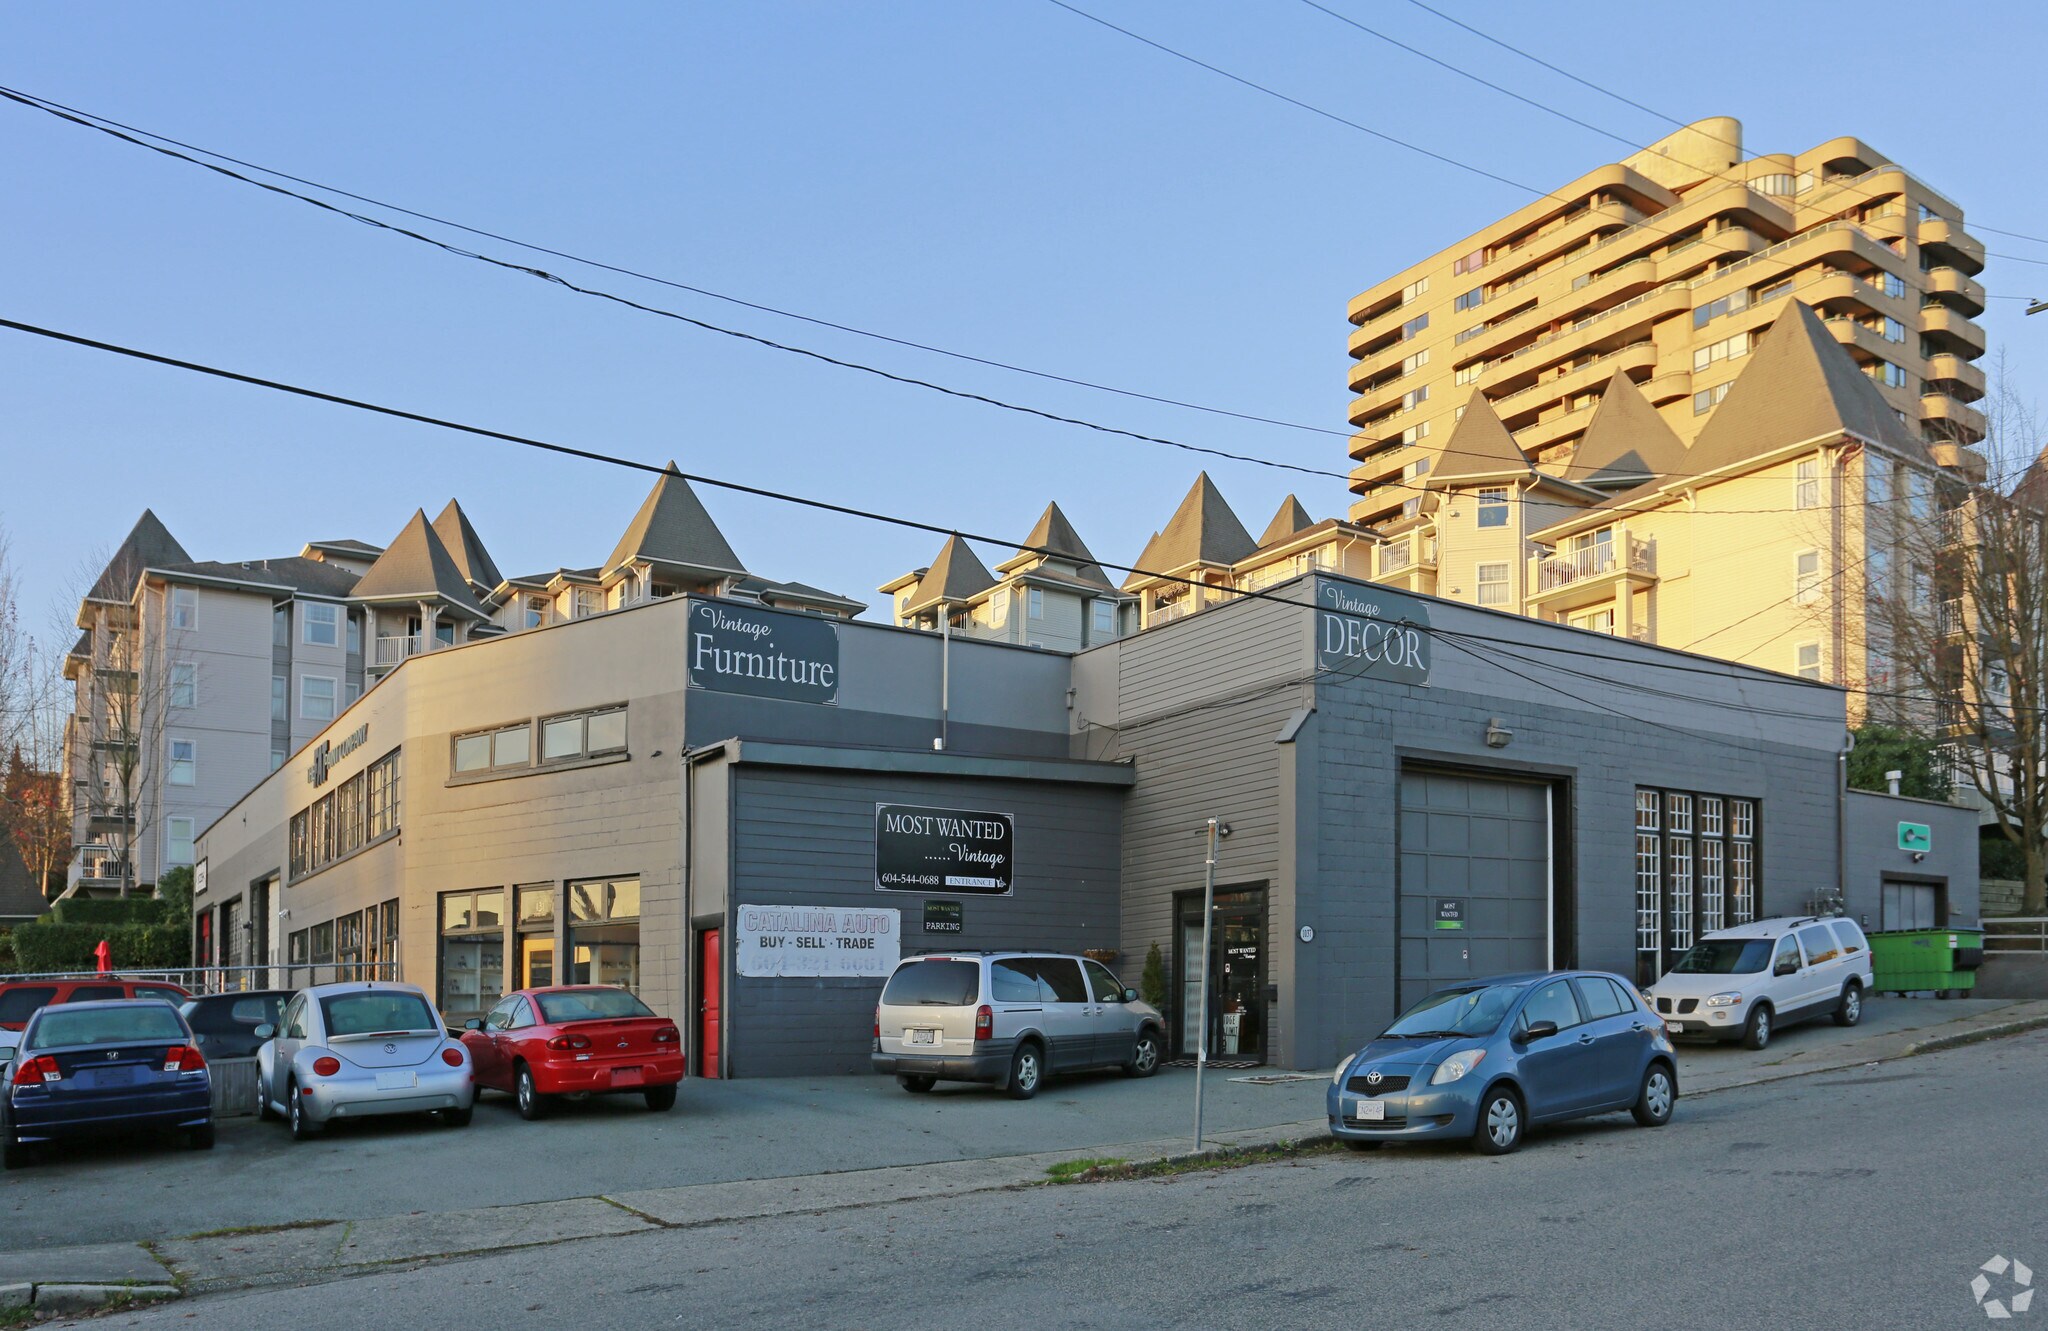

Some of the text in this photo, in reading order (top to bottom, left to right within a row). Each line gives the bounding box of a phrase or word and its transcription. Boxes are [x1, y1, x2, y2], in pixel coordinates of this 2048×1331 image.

[1326, 587, 1381, 620] Vintage
[700, 607, 772, 641] Vintage
[1323, 614, 1426, 671] DECOR
[694, 632, 834, 688] Furniture
[885, 813, 1005, 841] MOST WANTED
[949, 843, 1006, 870] Vintage
[881, 872, 940, 886] 604-544-0688
[949, 877, 993, 887] ENTRANCE
[744, 911, 891, 935] CATALINA AUTO
[925, 921, 961, 931] PARKING
[759, 936, 786, 949] BUY
[796, 936, 826, 949] SELL
[836, 937, 875, 950] TRADE
